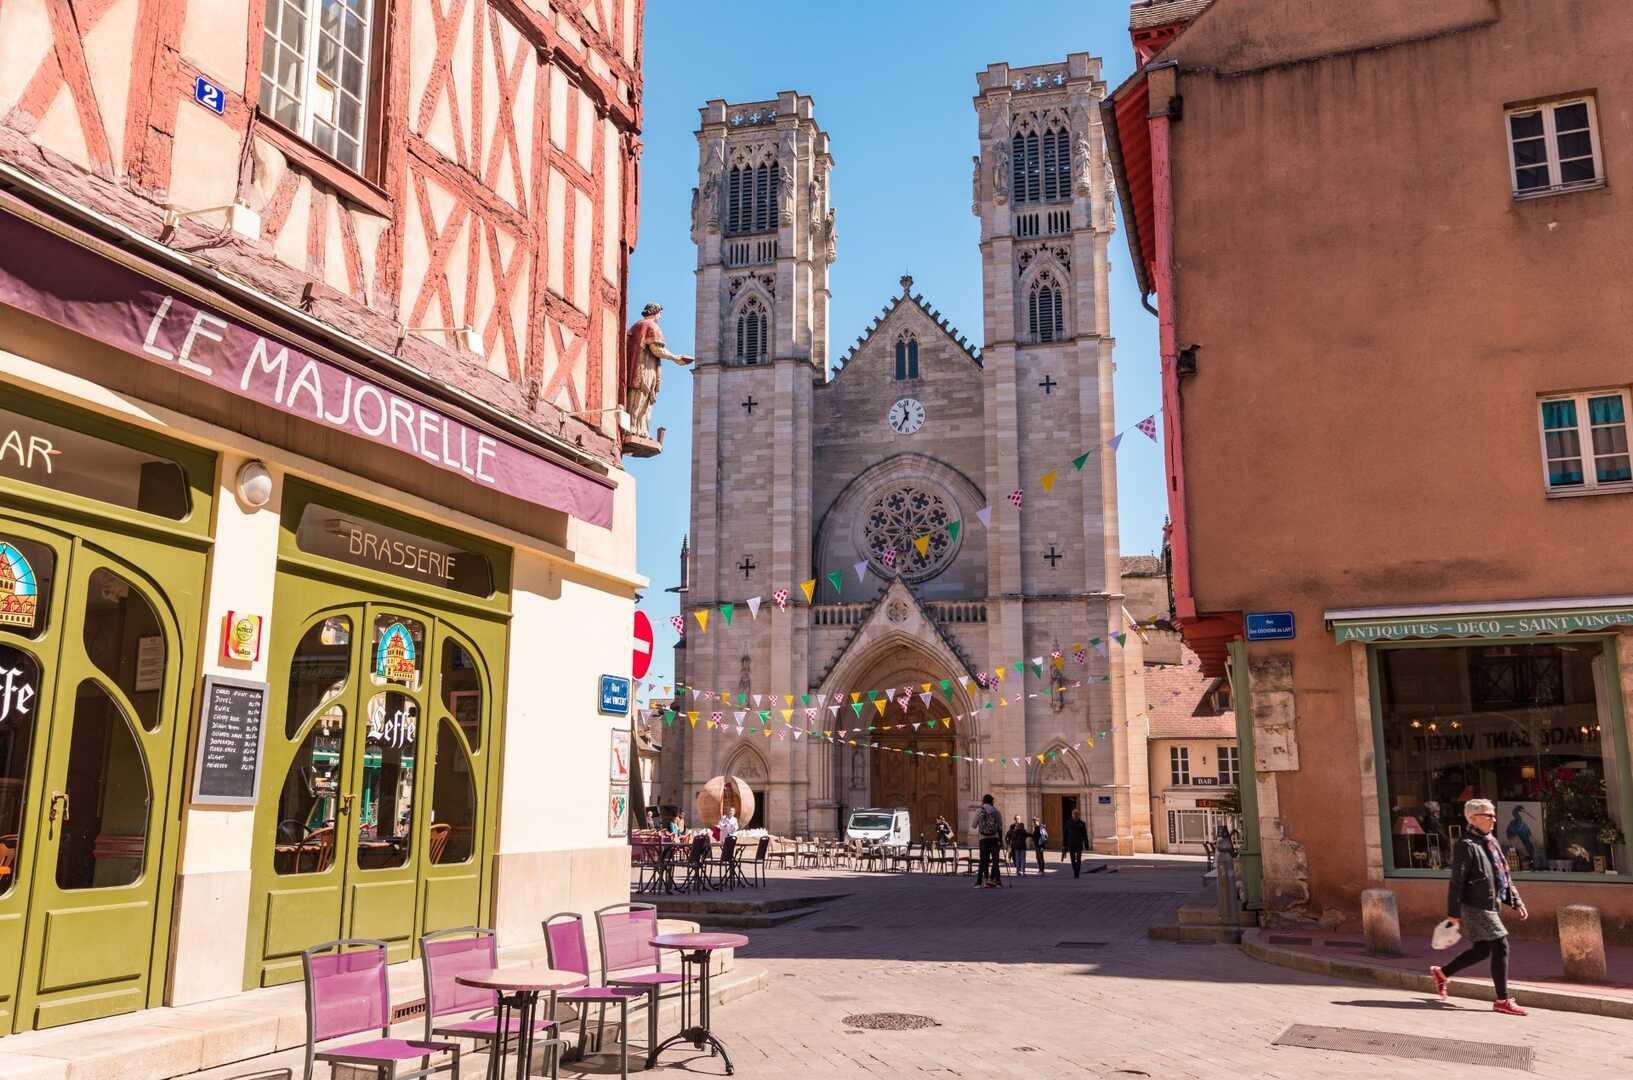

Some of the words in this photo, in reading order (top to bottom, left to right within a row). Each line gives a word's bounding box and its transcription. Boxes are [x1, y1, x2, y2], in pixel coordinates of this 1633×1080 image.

[203, 84, 218, 108] 2
[143, 295, 229, 376] LE
[240, 337, 497, 484] MAJORELLE
[349, 528, 456, 580] BRASSERIE
[1344, 622, 1439, 639] ANTIQUITES
[1456, 619, 1500, 634] DECO
[1519, 616, 1570, 632] SAINT
[611, 682, 620, 693] Rue
[611, 696, 627, 706] VINCENT
[367, 705, 416, 749] Leffe
